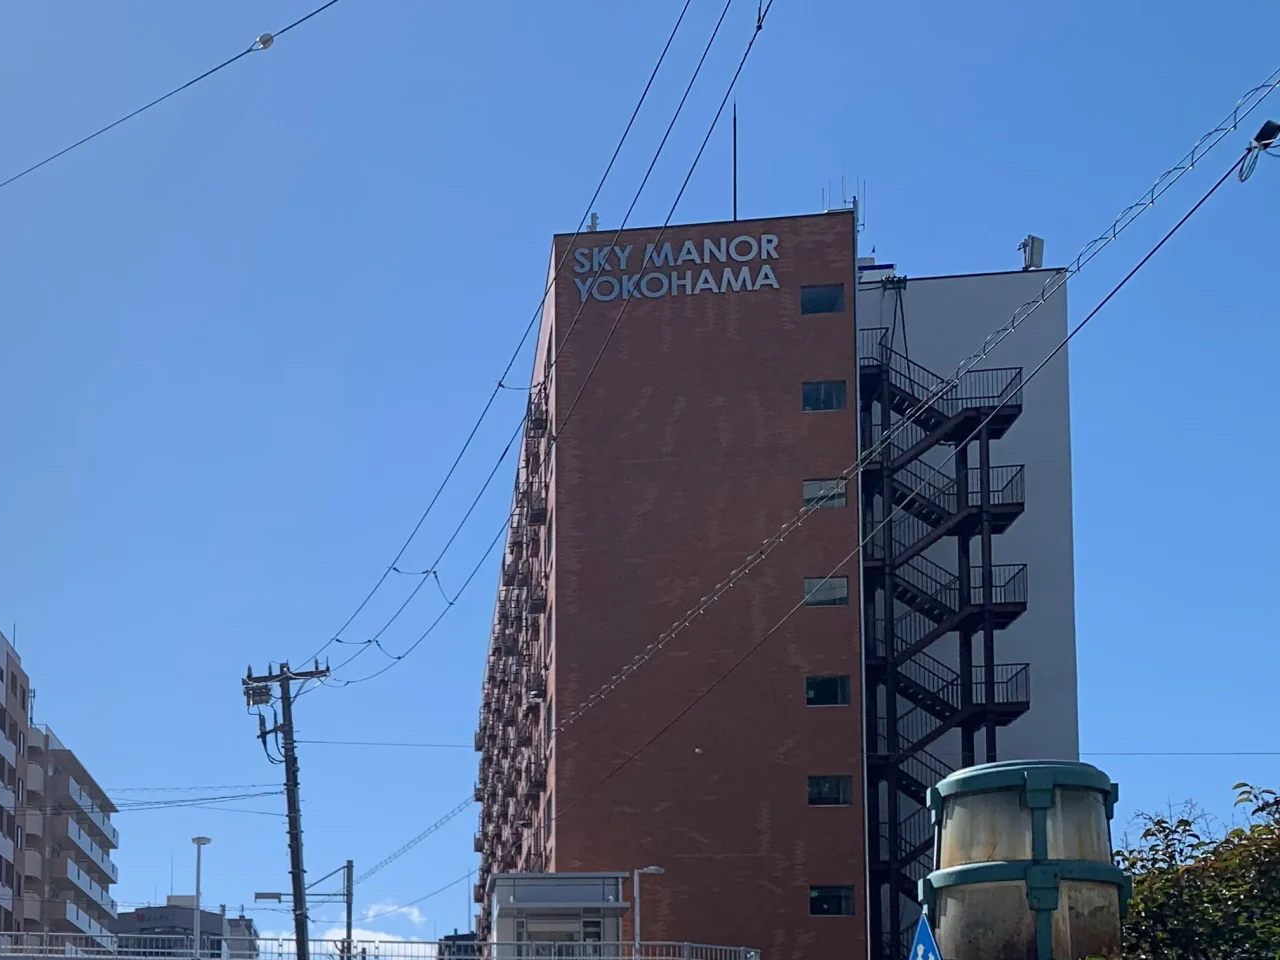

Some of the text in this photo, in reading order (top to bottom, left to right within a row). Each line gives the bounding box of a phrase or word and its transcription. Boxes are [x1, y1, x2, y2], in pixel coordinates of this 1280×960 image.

[573, 234, 779, 274] SKY MANOR
[573, 264, 779, 302] YOKOHAMA
